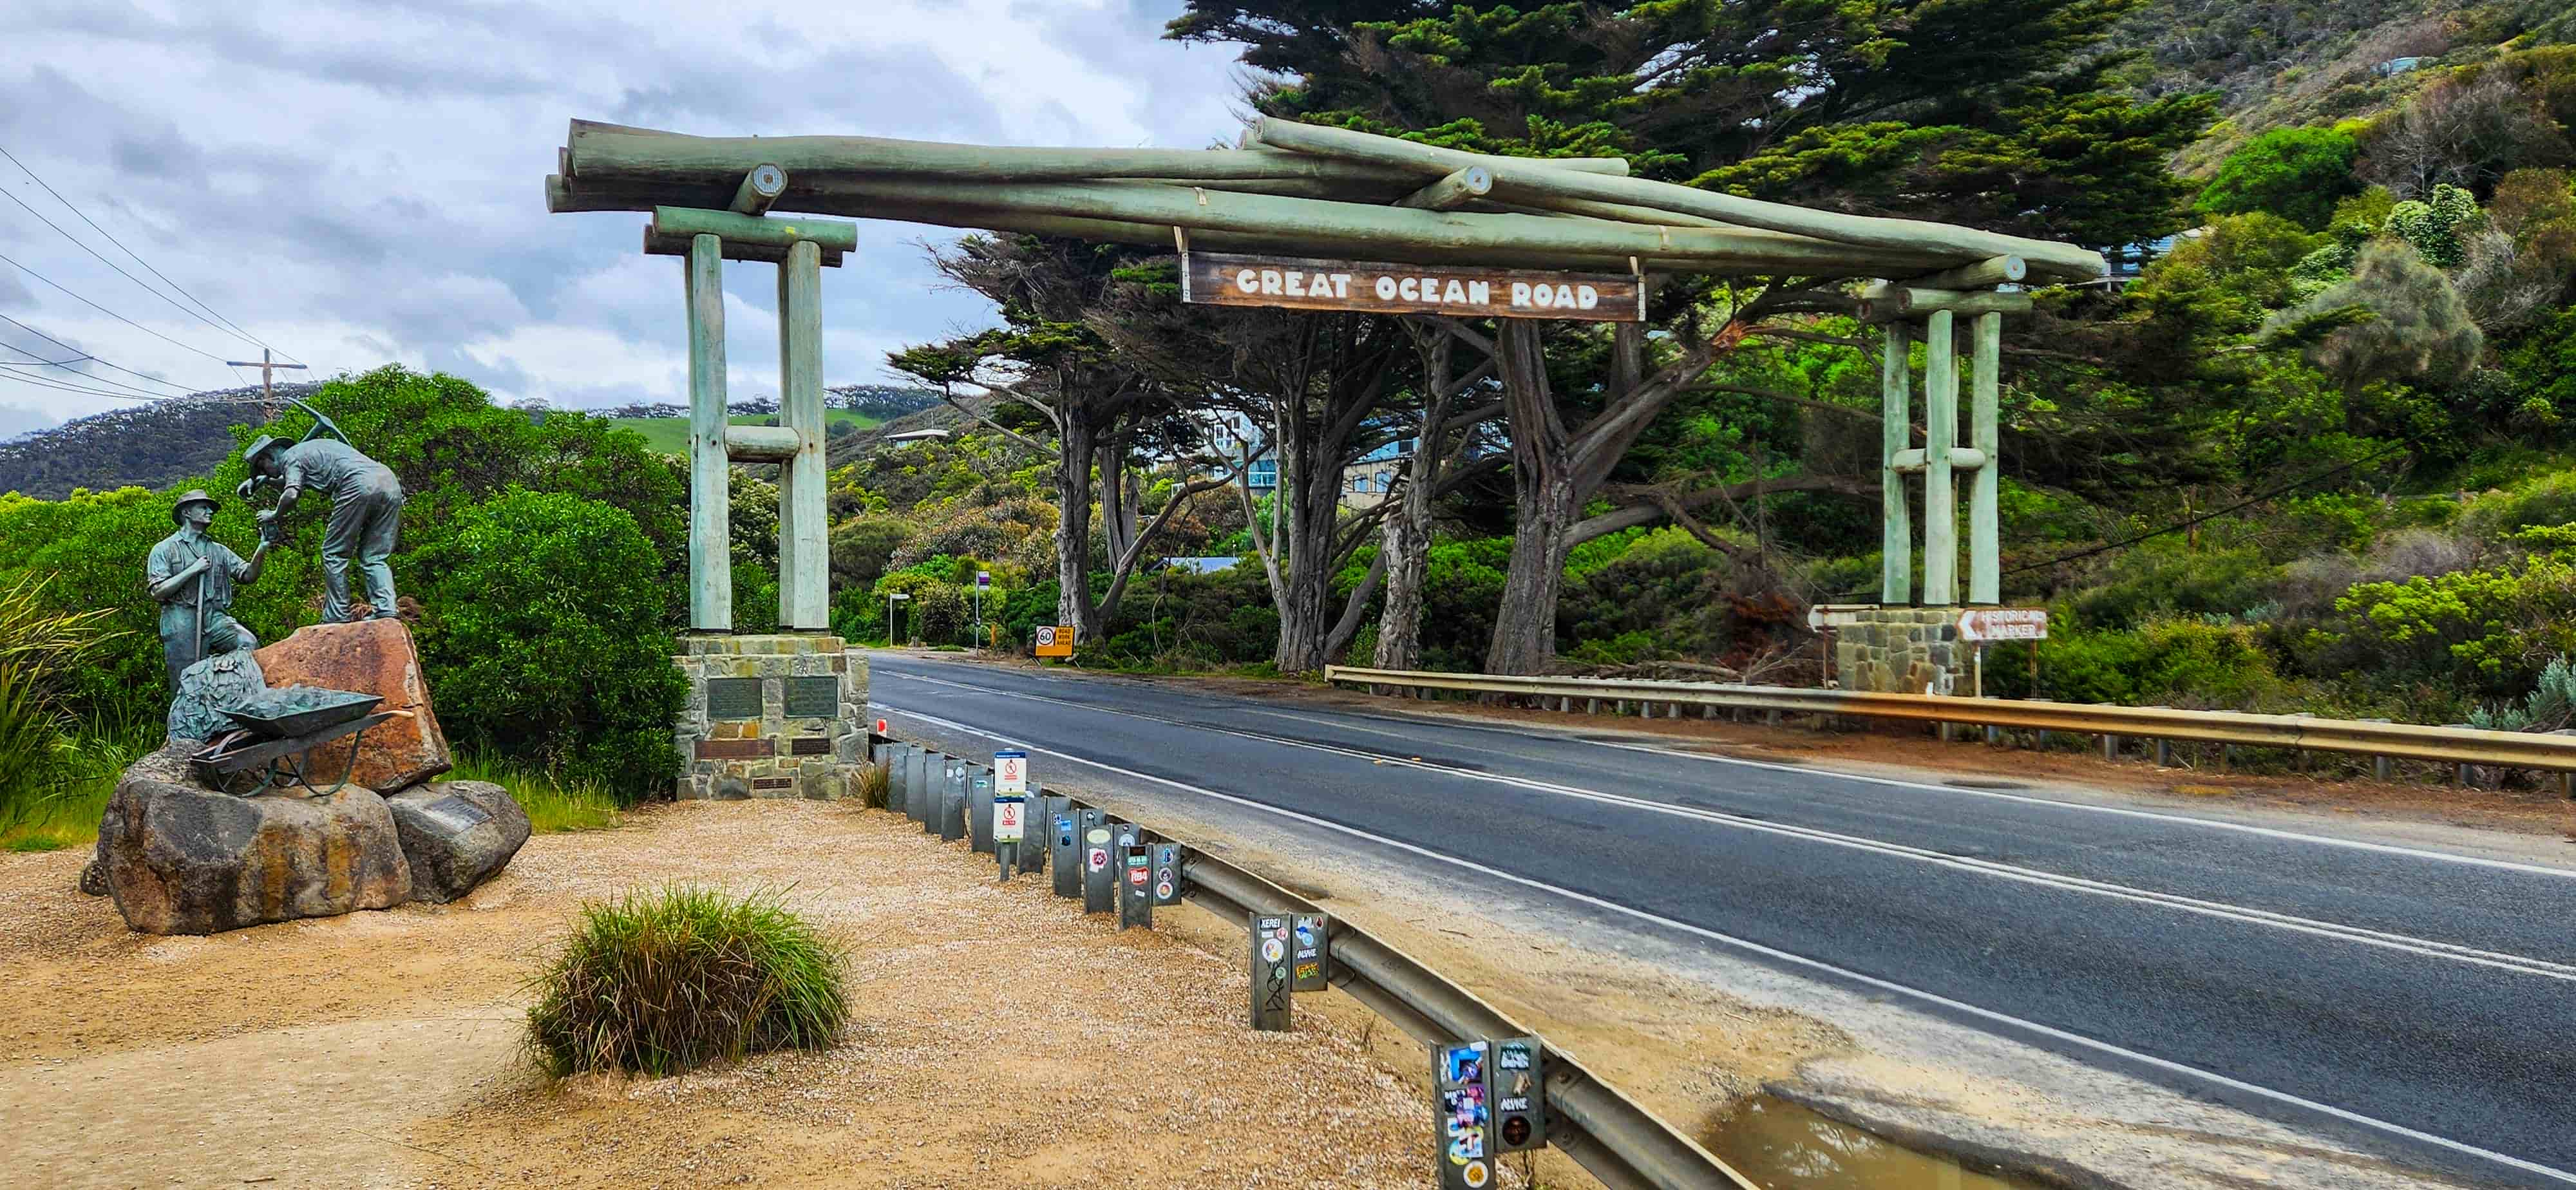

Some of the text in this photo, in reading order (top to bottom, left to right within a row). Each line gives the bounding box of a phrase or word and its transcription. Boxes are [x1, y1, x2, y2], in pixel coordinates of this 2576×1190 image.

[1236, 269, 1598, 310] GREAT OCEAN ROAD
[1987, 624, 2036, 637] MARKER
